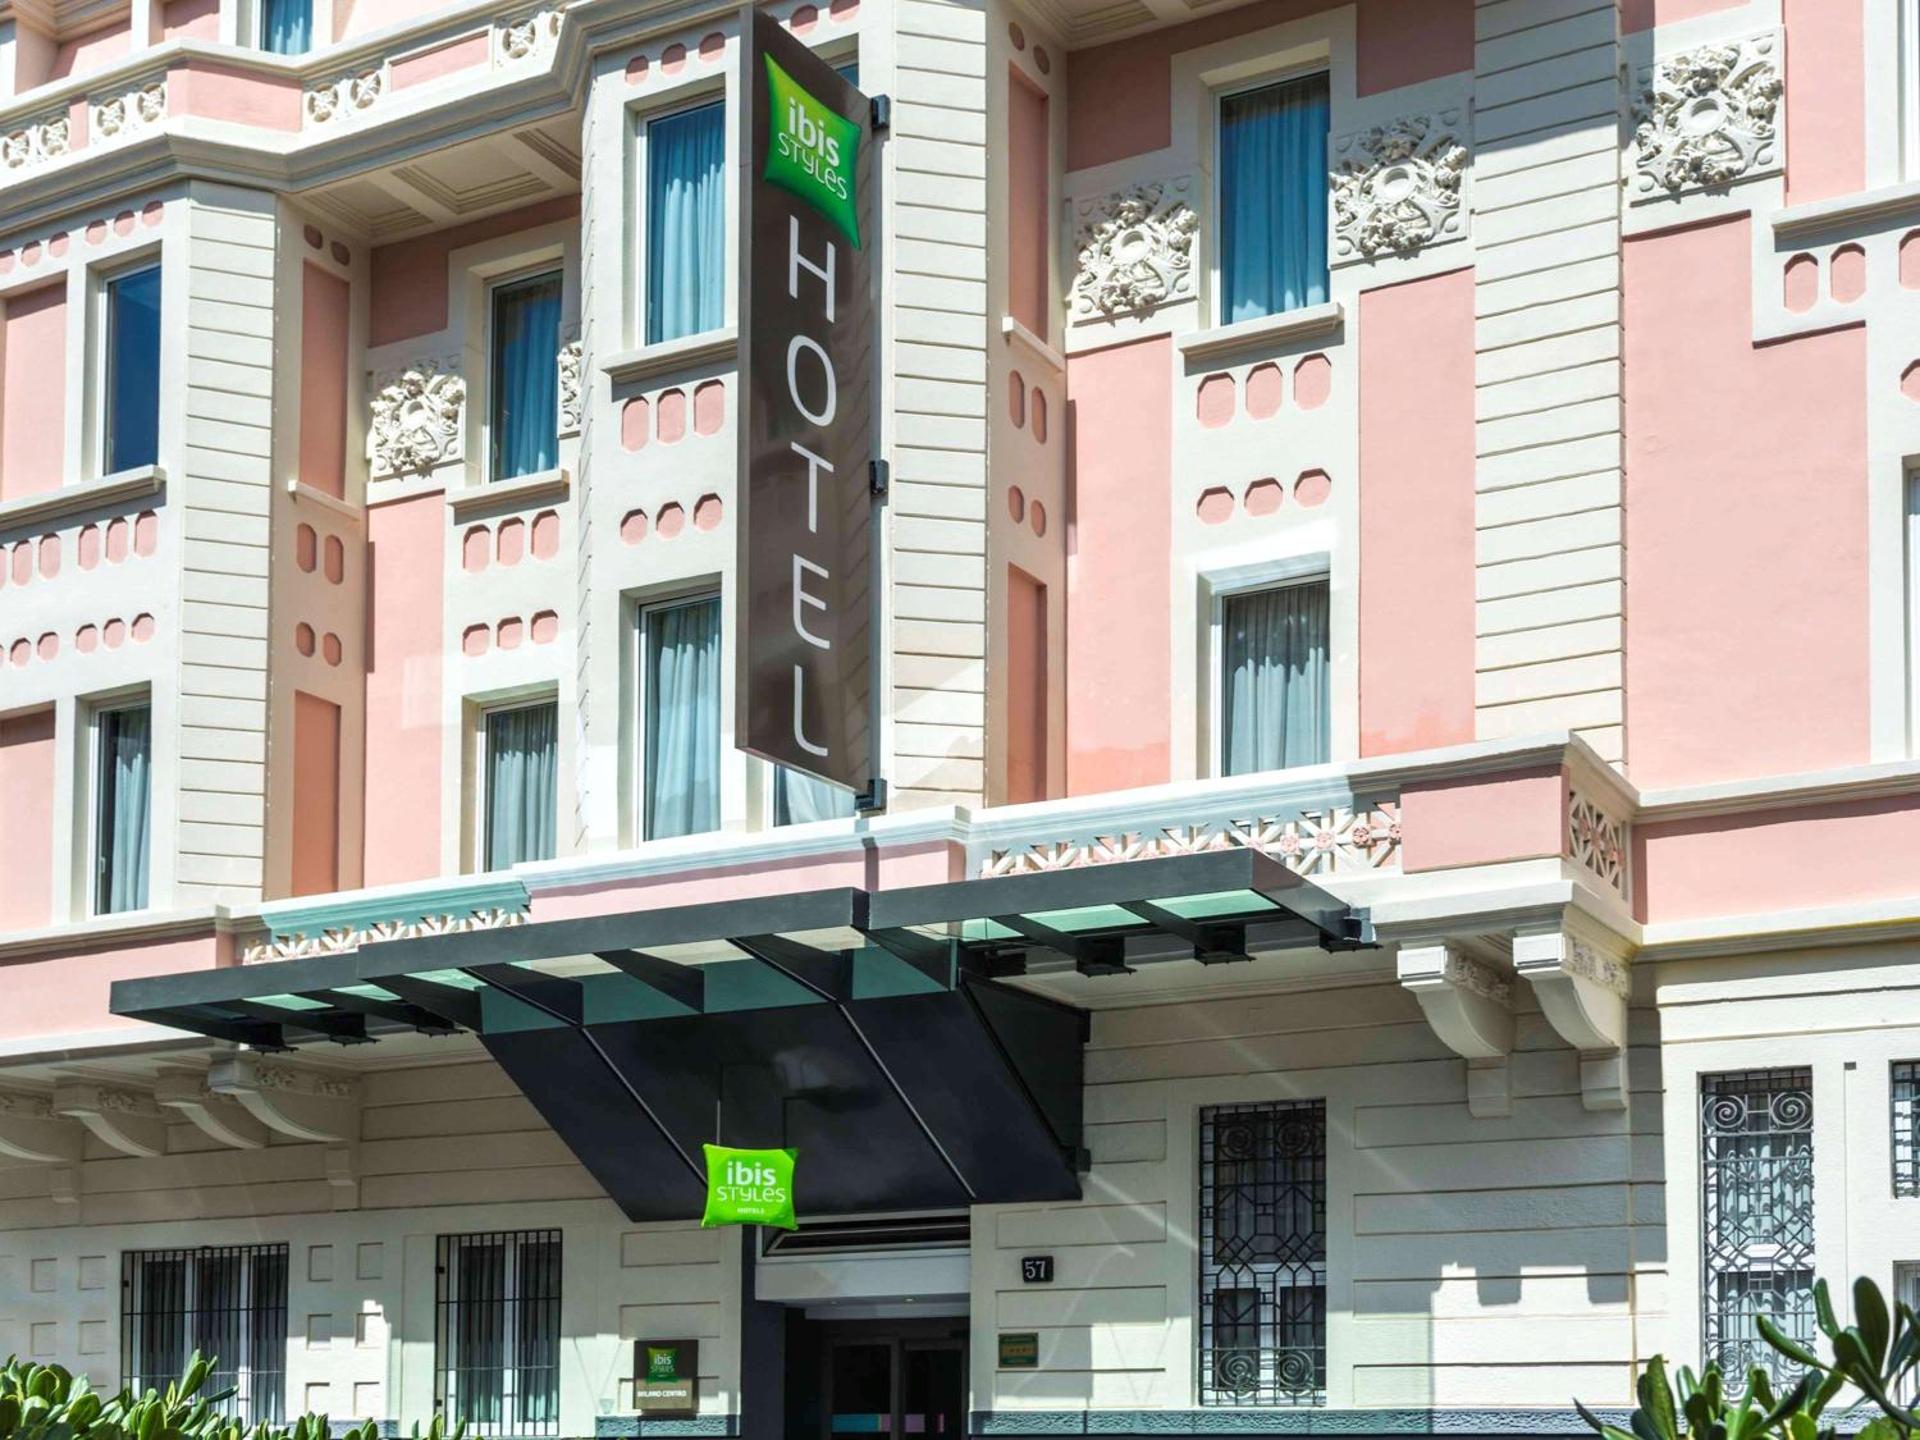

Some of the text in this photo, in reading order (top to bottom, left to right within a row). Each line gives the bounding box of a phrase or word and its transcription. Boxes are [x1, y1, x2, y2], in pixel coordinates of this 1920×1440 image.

[789, 97, 840, 167] ibis
[786, 214, 837, 757] HOTEL
[727, 1161, 776, 1187] ibis
[1024, 1261, 1046, 1279] 57
[654, 1353, 672, 1365] ibis
